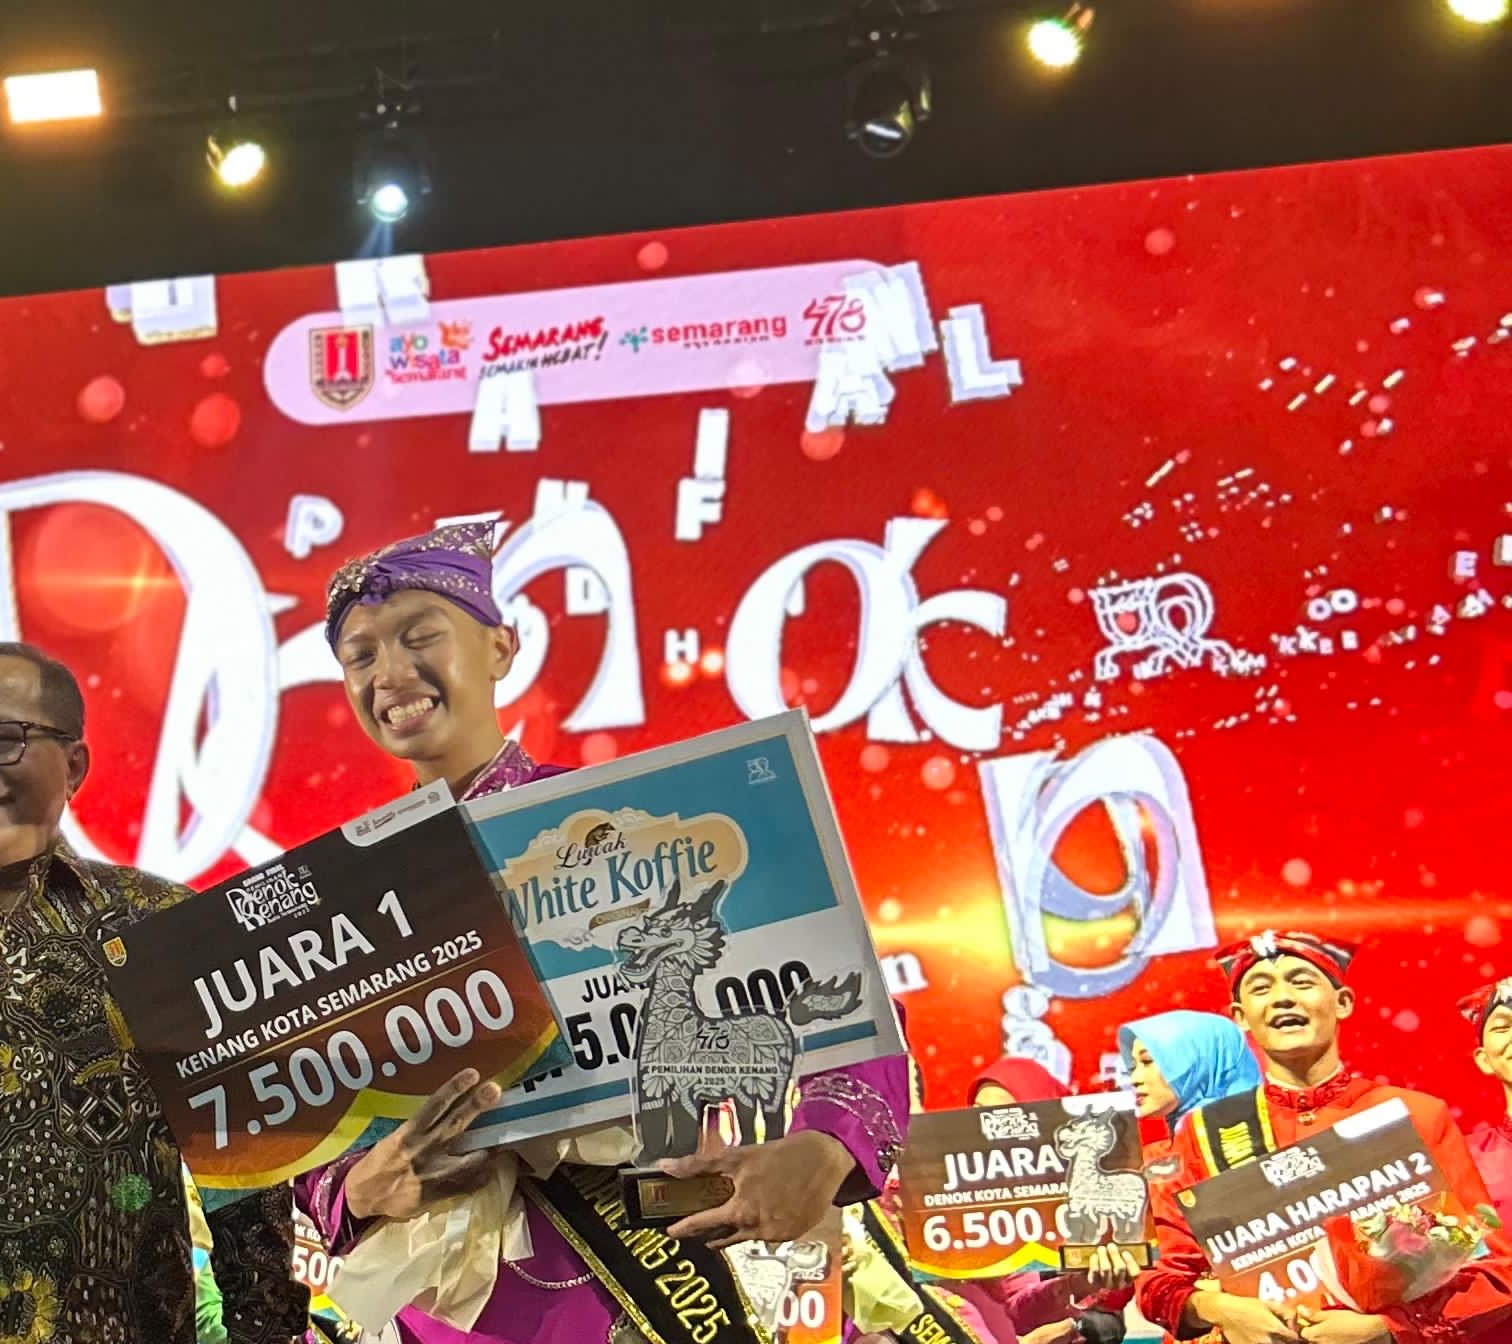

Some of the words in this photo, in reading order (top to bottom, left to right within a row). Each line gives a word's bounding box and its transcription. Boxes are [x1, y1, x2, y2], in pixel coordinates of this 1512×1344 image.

[390, 333, 428, 358] ayo
[481, 315, 605, 362] SEMARANG
[651, 316, 787, 345] semarang
[499, 872, 599, 931] White
[605, 835, 719, 904] Koffie
[193, 913, 376, 1040] JUARA
[378, 889, 414, 939] 1
[582, 973, 646, 1003] JUA
[176, 1029, 259, 1079] KENANG
[260, 1004, 318, 1042] KOTA
[317, 953, 431, 1016] SEMARANG
[432, 929, 483, 966] 2025
[188, 969, 515, 1151] 7.500.000
[651, 1065, 703, 1075] PEMILIHAN
[705, 1065, 737, 1075] DENOK
[739, 1065, 778, 1075] KENANG
[944, 1144, 1065, 1191] JUARA
[924, 1188, 972, 1207] DENOK
[975, 1187, 1011, 1203] KOTA
[1014, 1182, 1069, 1199] SEMARA
[1206, 1211, 1290, 1264] JUARA
[1285, 1158, 1412, 1226] HARAPAN
[1407, 1152, 1432, 1175] 2
[923, 1203, 1072, 1252] 6.500.0
[1231, 1239, 1287, 1271] KENANG
[1288, 1226, 1326, 1248] KOTA
[1350, 1194, 1398, 1223] ARANG
[654, 1259, 731, 1344] 2025
